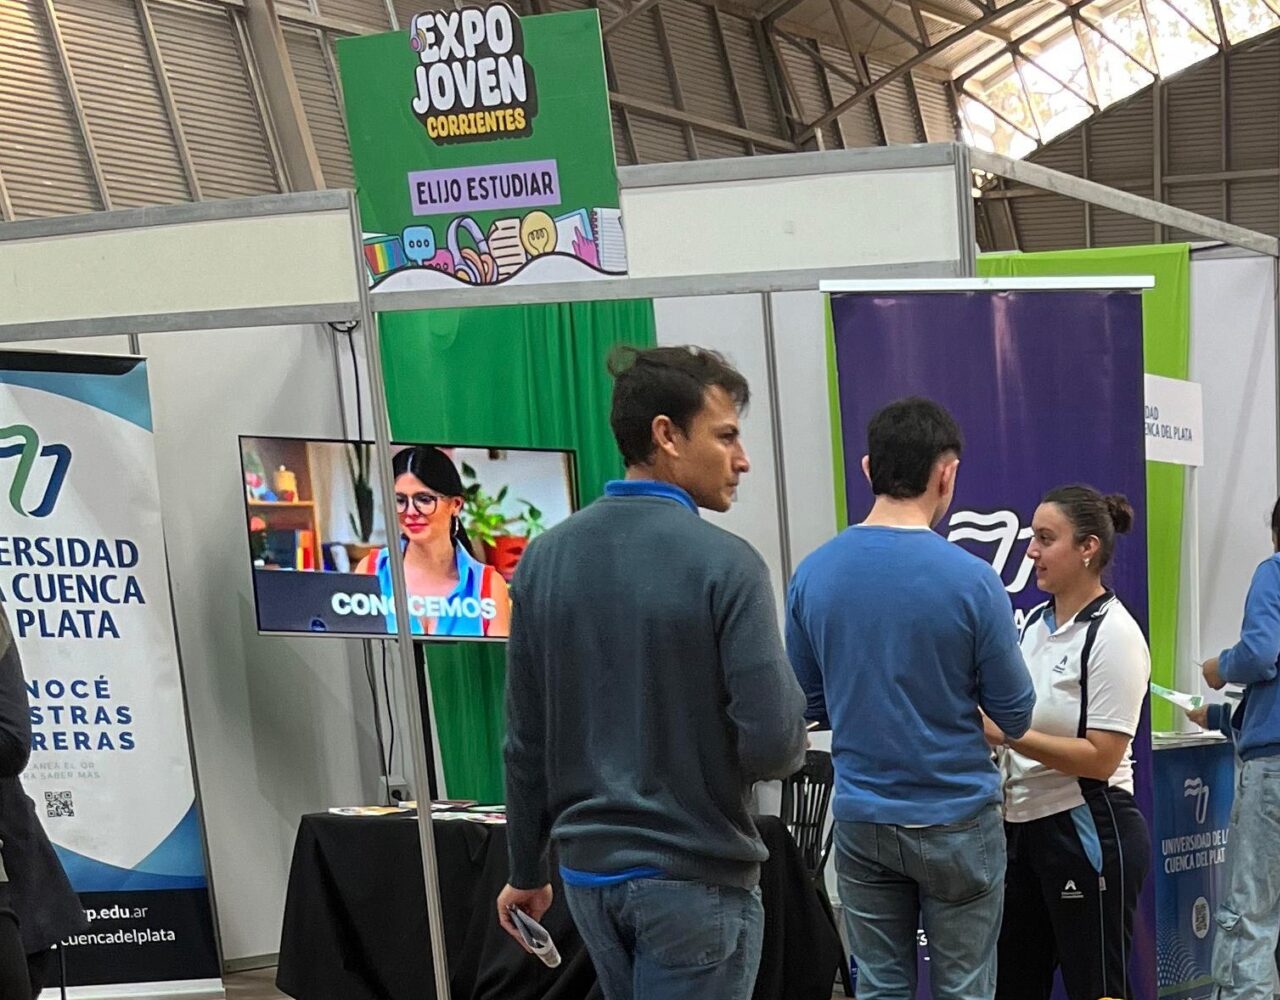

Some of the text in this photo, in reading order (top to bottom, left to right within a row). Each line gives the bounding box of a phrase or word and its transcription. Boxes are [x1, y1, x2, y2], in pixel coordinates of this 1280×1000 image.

[417, 5, 513, 63] EXPO
[412, 54, 527, 114] JOVEN
[426, 107, 527, 139] CORRIENTES
[416, 171, 555, 205] ELIJO ESTUDIAR
[1161, 425, 1173, 439] DEL
[1173, 426, 1193, 442] PLATA
[11, 573, 146, 605] CUENCA
[15, 609, 121, 639] PLATA
[1161, 832, 1211, 856] UNIVERSIDAD
[1212, 830, 1221, 846] DE
[1164, 852, 1195, 874] CUENCA
[1195, 850, 1209, 868] DEL
